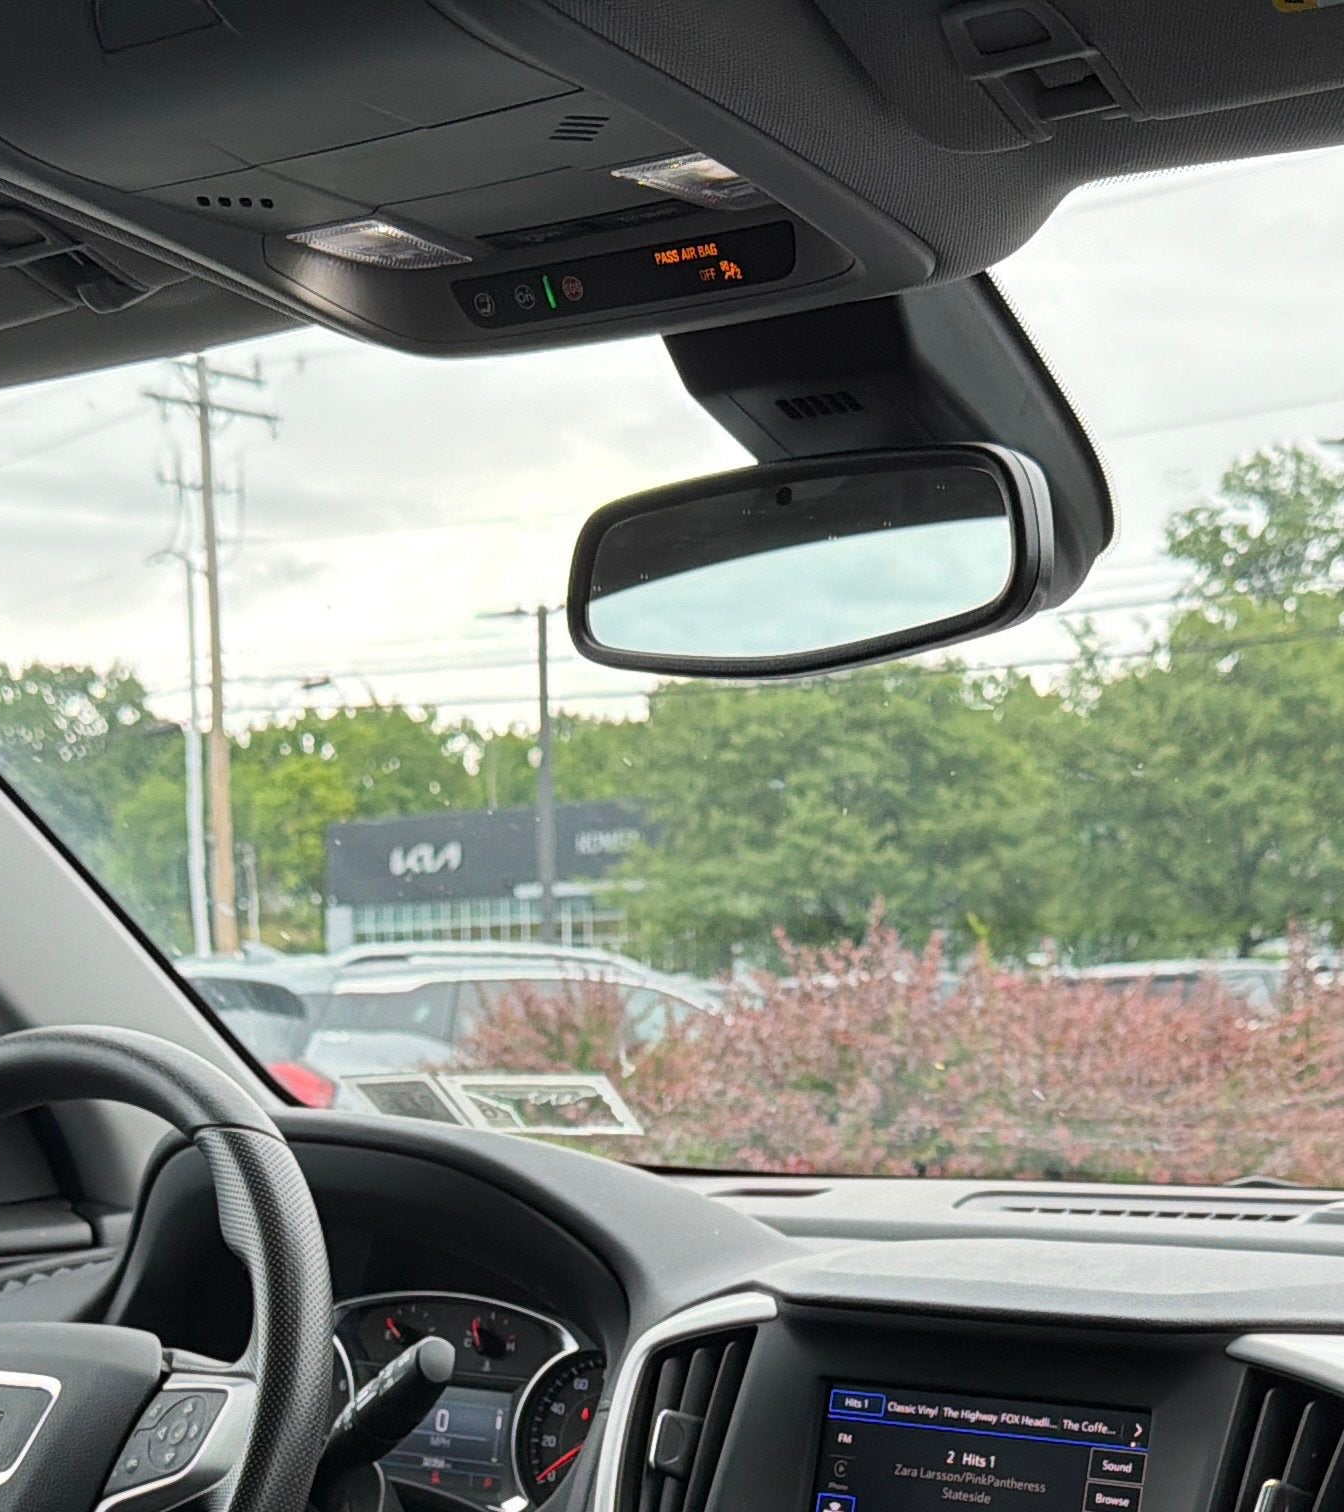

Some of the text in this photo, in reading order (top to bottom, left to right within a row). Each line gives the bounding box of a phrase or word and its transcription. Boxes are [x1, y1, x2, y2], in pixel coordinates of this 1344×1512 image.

[654, 243, 718, 265] PASS AIR BAG
[699, 267, 716, 281] OFF
[389, 841, 462, 876] KIA
[550, 1402, 565, 1415] 40
[845, 1397, 863, 1409] Hits
[887, 1401, 938, 1418] Classic Vinyl
[435, 1408, 450, 1432] 0
[942, 1406, 998, 1424] The Highway
[1000, 1413, 1020, 1425] FOX
[1062, 1419, 1080, 1431] The
[541, 1435, 556, 1448] 20
[837, 1432, 853, 1444] FM
[946, 1450, 956, 1464] 2
[962, 1452, 987, 1468] Hits
[1102, 1459, 1133, 1474] Sound
[894, 1464, 1047, 1493] Zara Larsson/PinkPantheress
[941, 1487, 992, 1504] Stateside
[1095, 1492, 1130, 1507] Browse
